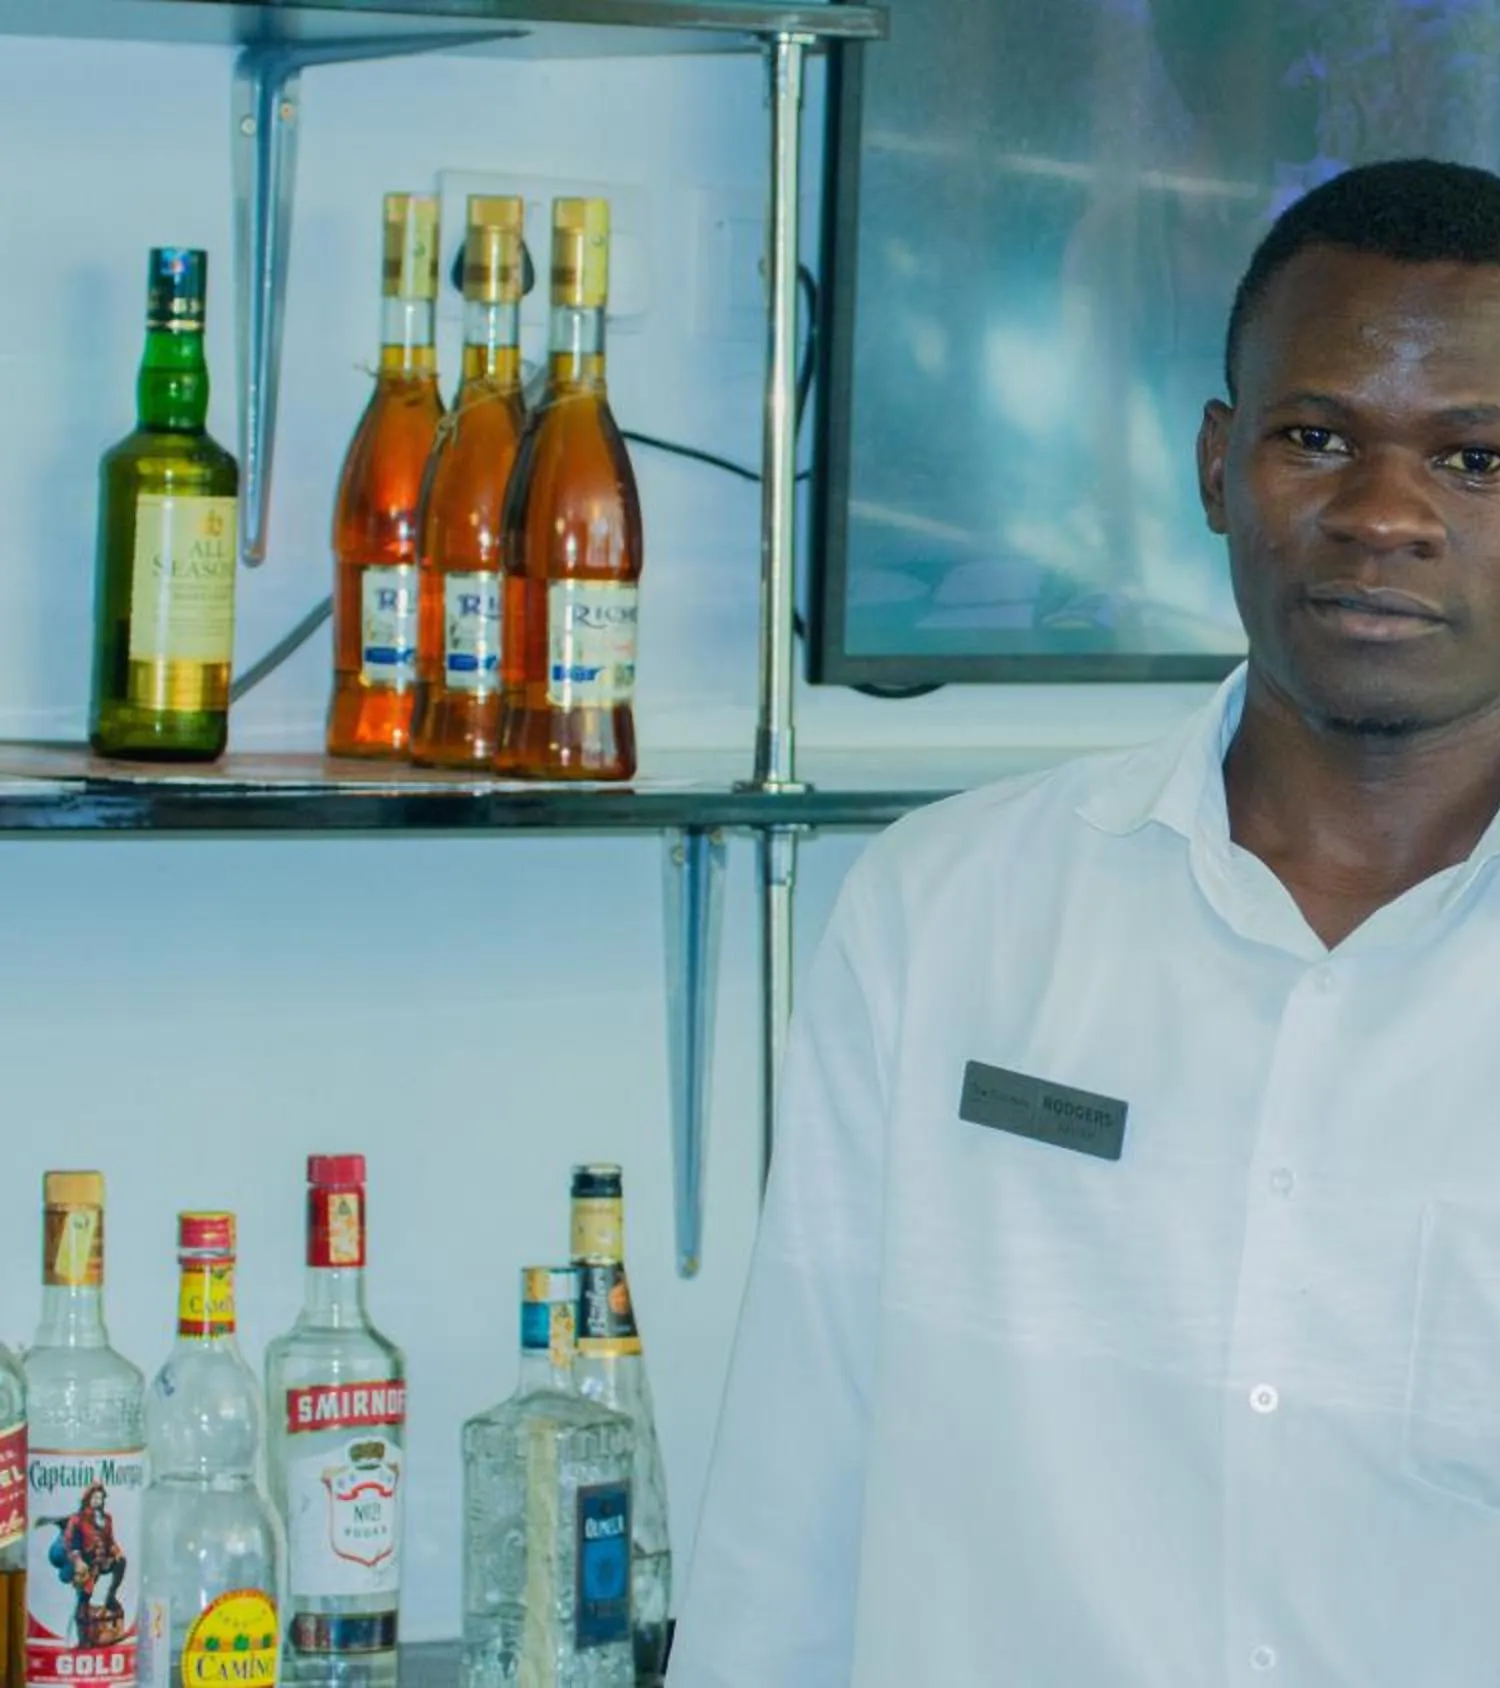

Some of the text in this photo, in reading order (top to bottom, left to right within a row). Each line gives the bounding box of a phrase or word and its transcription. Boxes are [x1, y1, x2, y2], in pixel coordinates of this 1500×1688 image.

[189, 540, 225, 558] ALL
[29, 1460, 93, 1494] Captain
[56, 1653, 125, 1675] GOLD
